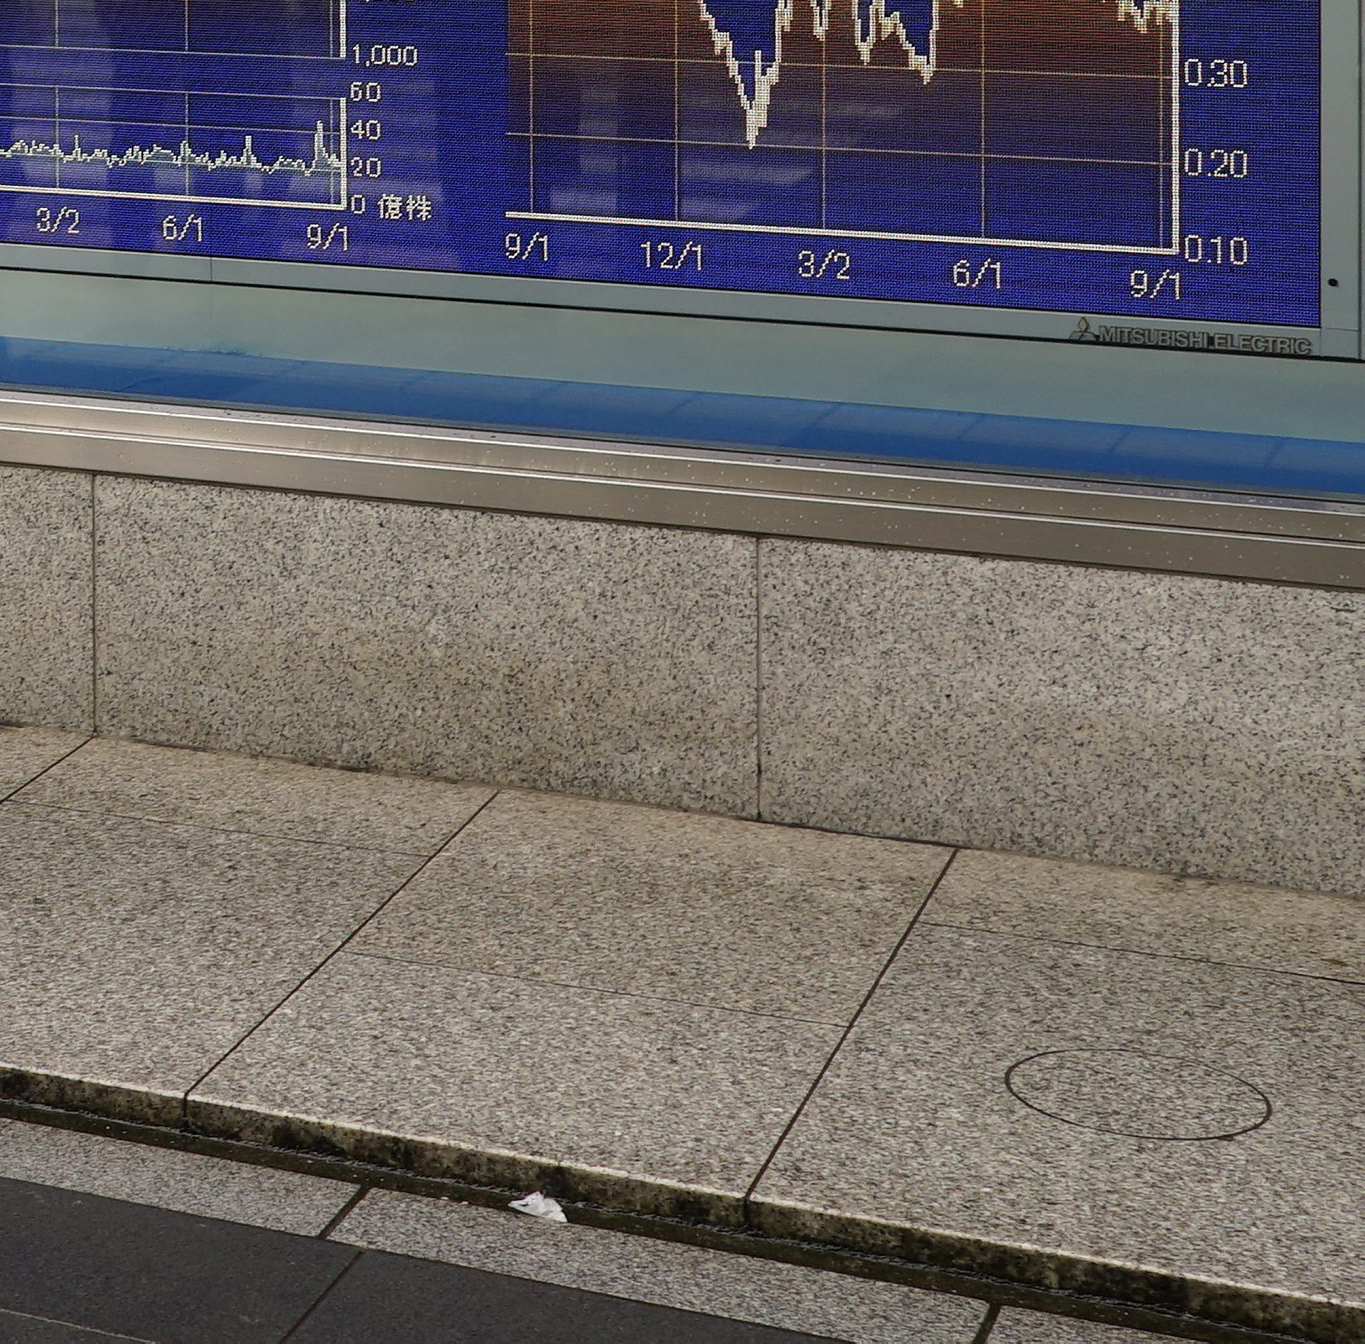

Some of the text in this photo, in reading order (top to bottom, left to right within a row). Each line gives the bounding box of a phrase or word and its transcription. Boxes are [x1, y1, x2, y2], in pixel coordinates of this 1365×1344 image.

[351, 45, 418, 67] 1,000
[1184, 59, 1248, 88] 0.30
[351, 82, 381, 101] 60
[351, 120, 381, 140] 40
[351, 157, 382, 178] 20
[1184, 148, 1248, 179] 0.20
[351, 195, 366, 214] 0
[36, 206, 79, 234] 3/2
[162, 214, 202, 242] 6/1
[306, 223, 349, 251] 9/1
[1184, 234, 1248, 265] 0.10
[504, 232, 1181, 300] 9/1 12/1 3/2 6/1 9/1
[1097, 325, 1312, 355] MITSUBISHI ELECTRIC
